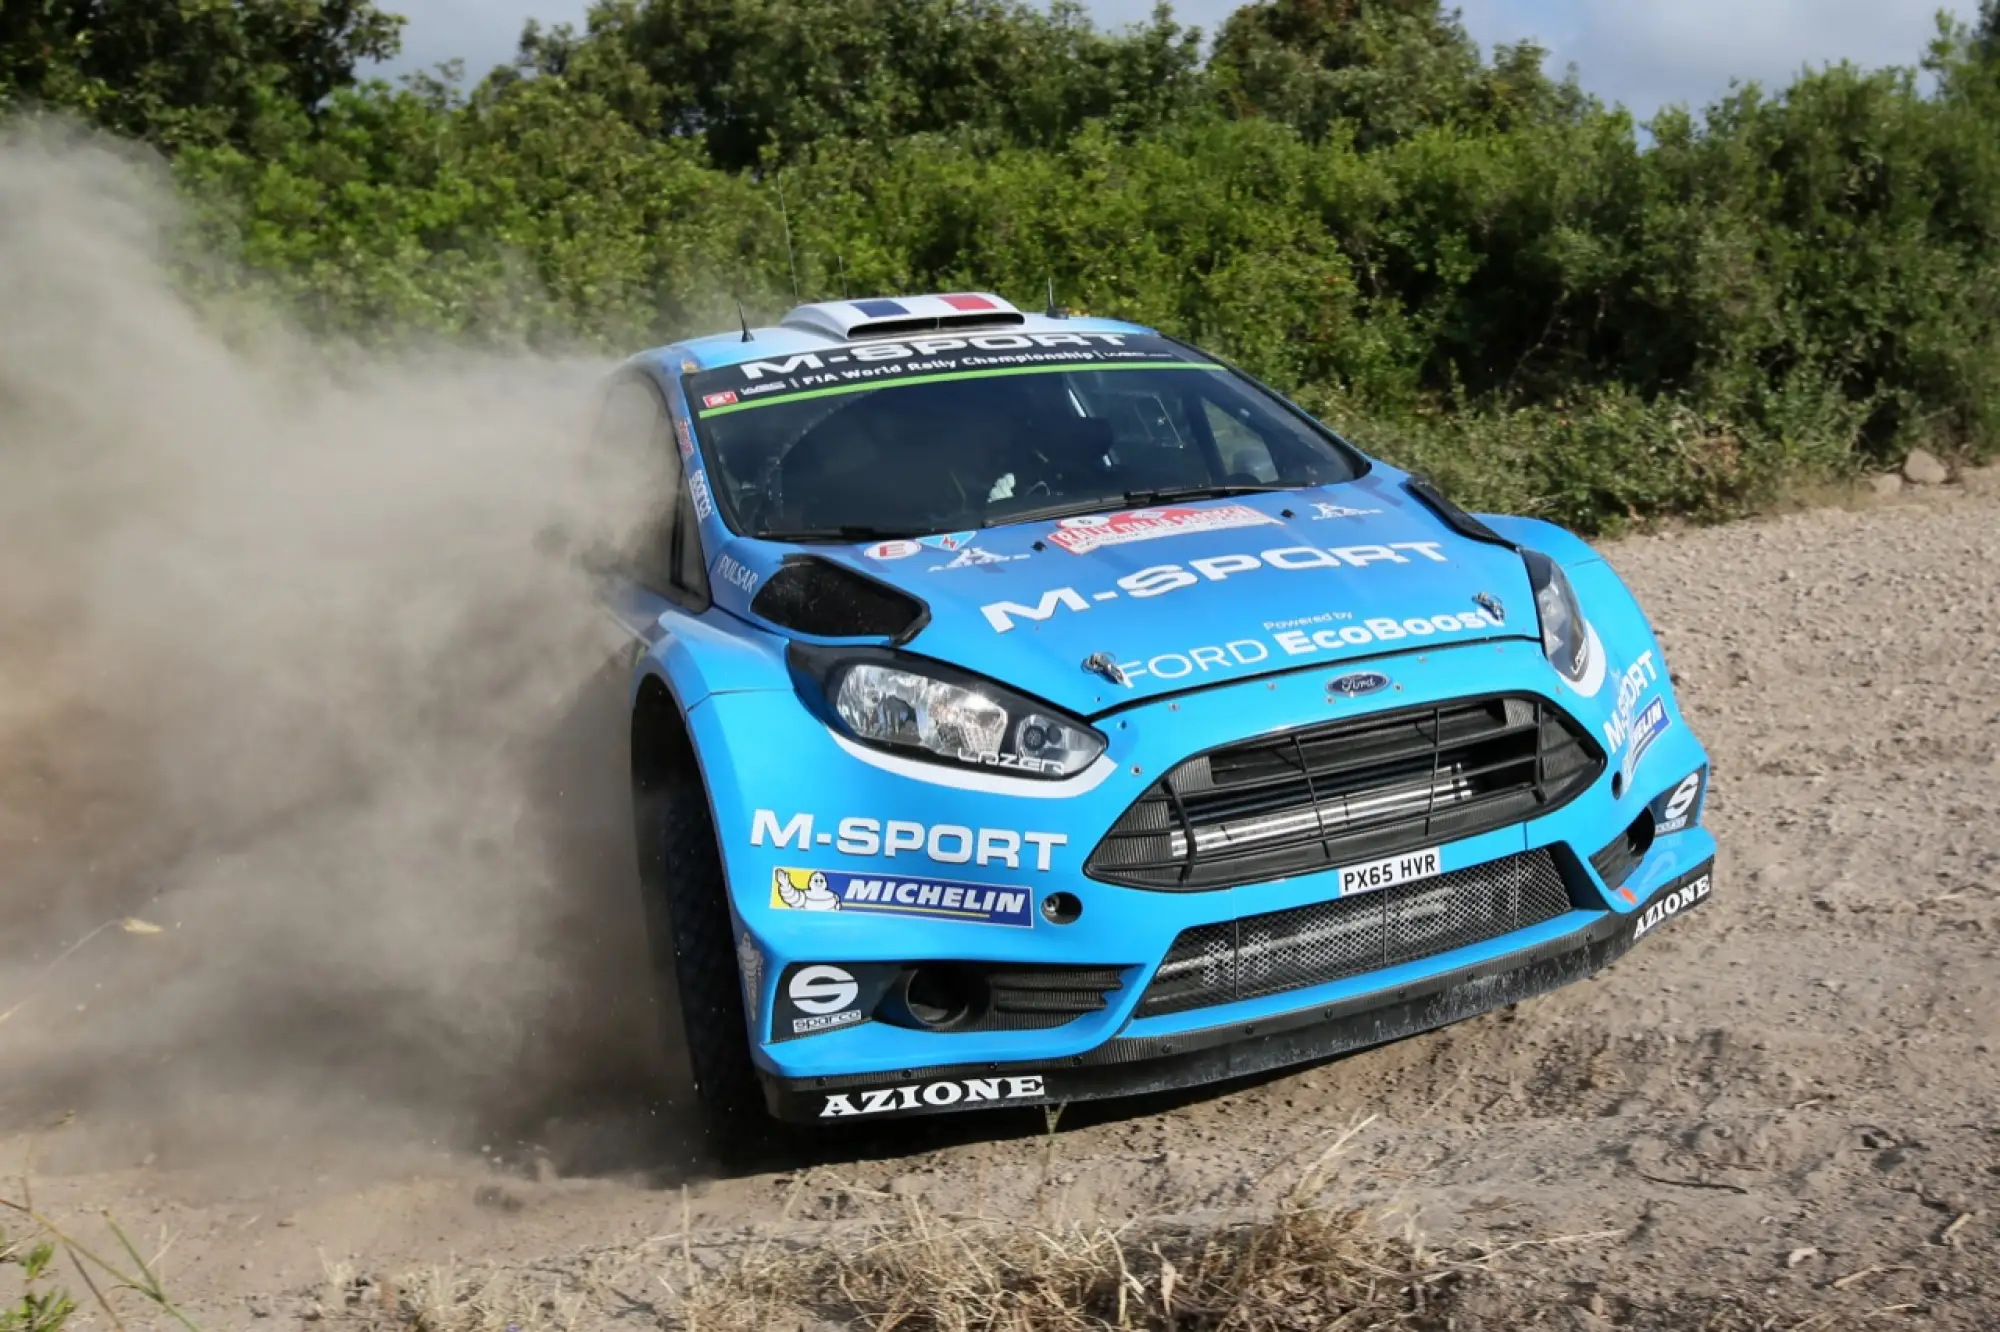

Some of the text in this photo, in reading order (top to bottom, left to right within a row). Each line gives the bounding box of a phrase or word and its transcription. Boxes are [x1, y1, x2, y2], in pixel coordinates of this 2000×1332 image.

[740, 333, 1126, 380] M-SPORT
[802, 373, 838, 385] FIA
[841, 363, 902, 379] World
[908, 360, 957, 372] Rally
[961, 351, 1094, 366] Championship
[717, 555, 758, 592] PULSAR
[980, 541, 1448, 633] M-SPORT
[1263, 611, 1353, 630] Powered by
[1116, 607, 1505, 689] FORD EcoBoost
[1341, 675, 1376, 691] Ford
[751, 808, 1067, 871] M-SPORT
[1344, 853, 1435, 892] PX65 HVR
[844, 879, 1025, 913] MICHELIN
[1633, 874, 1710, 940] AZIONE
[793, 1011, 861, 1033] sparco
[819, 1075, 1045, 1117] AZIONE
